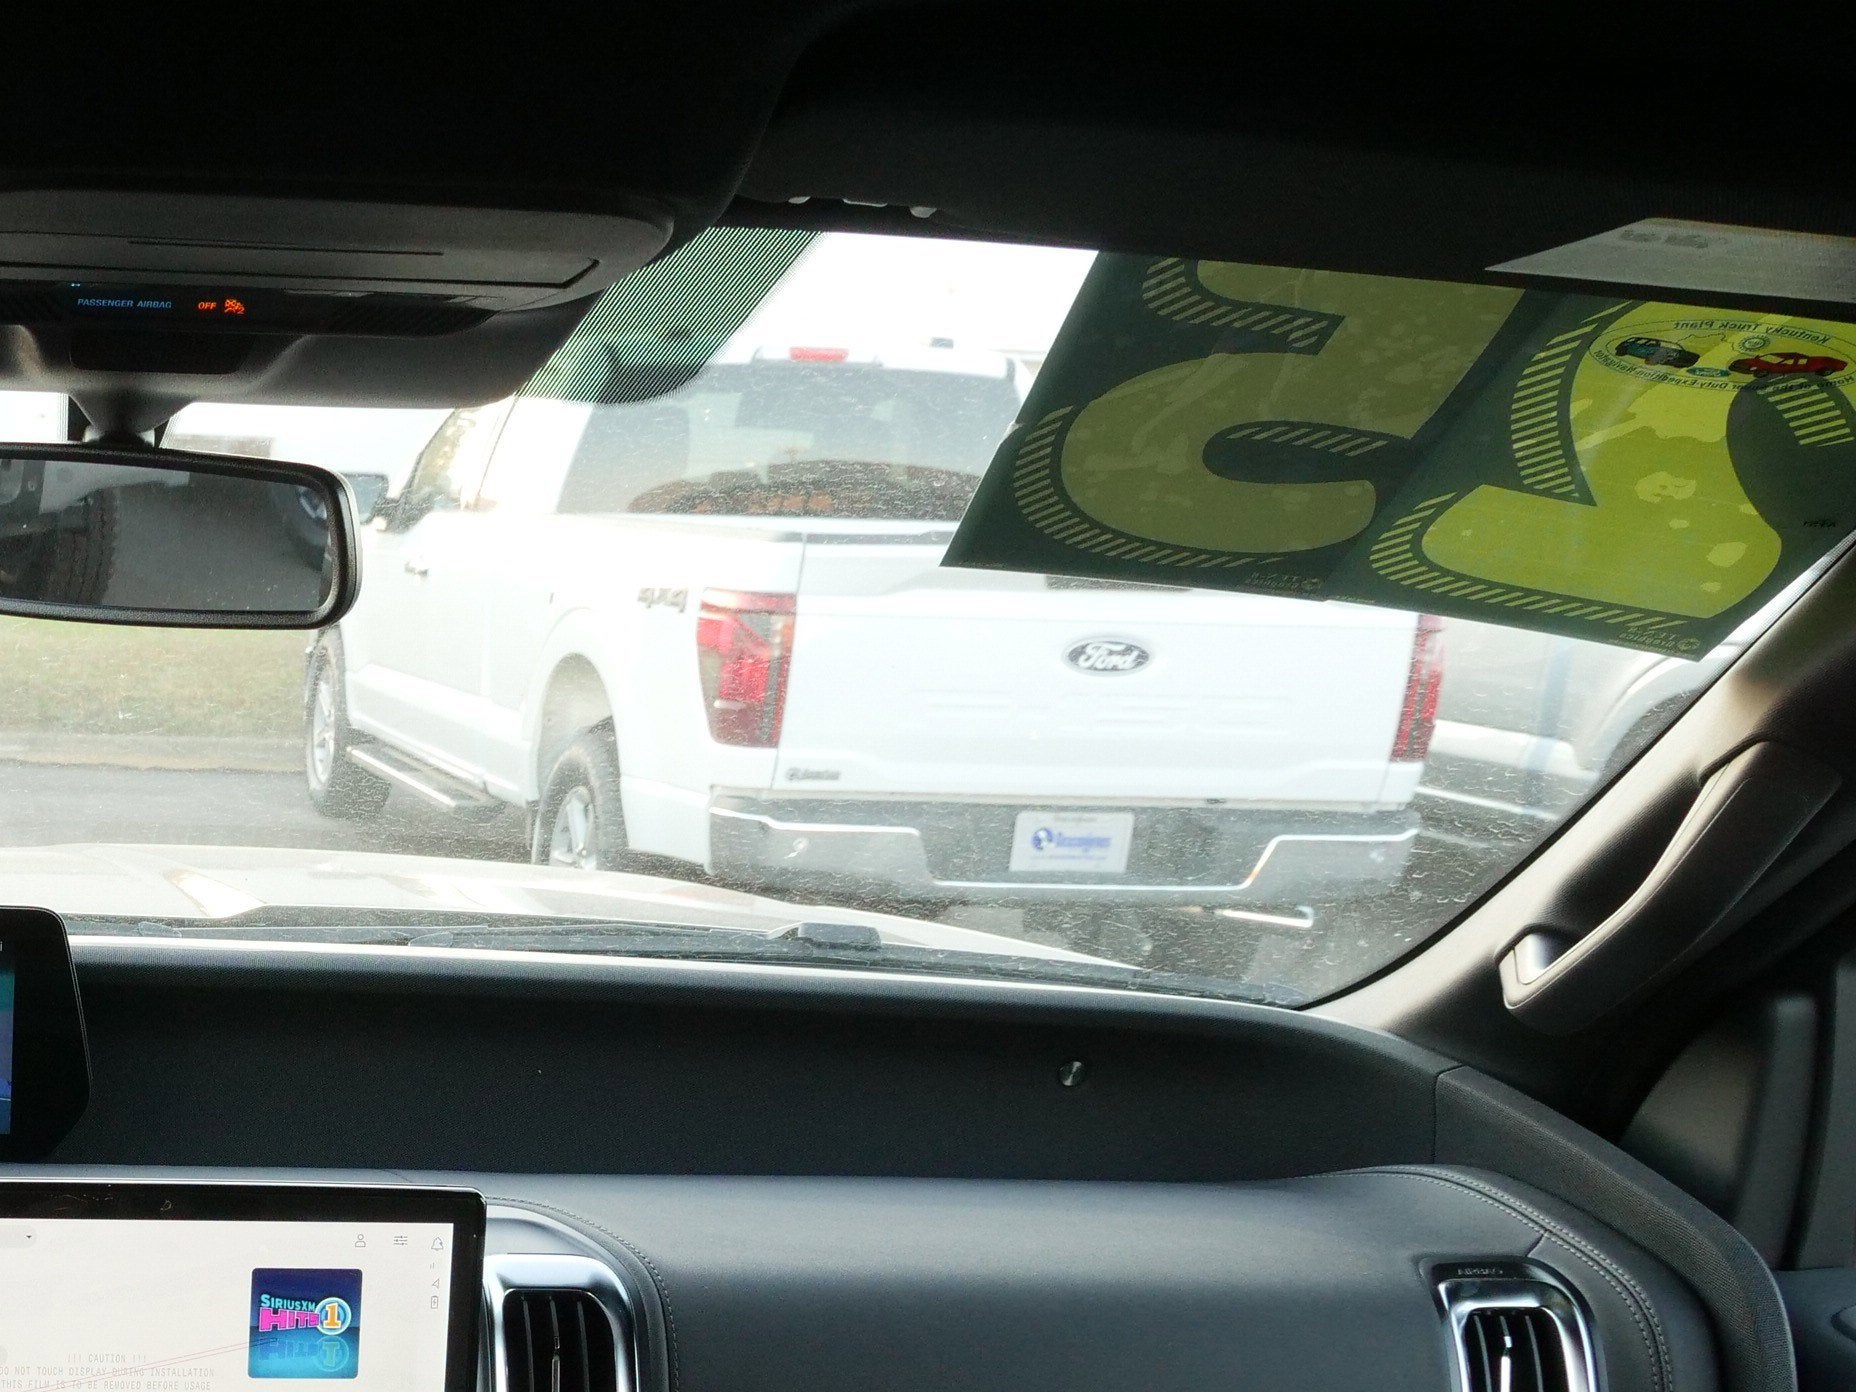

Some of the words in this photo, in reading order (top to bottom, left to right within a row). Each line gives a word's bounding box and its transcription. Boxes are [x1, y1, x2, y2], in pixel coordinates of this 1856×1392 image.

[77, 298, 133, 308] PASSENGER
[137, 301, 172, 309] AIRBAG
[198, 302, 216, 310] OFF
[1077, 638, 1143, 672] Ford
[259, 1307, 320, 1332] HITS
[323, 1302, 342, 1328] 1
[88, 1354, 127, 1363] CAUTION
[14, 1367, 31, 1376] NOT
[37, 1367, 64, 1376] TOUCH
[68, 1367, 107, 1377] DISPLAY
[150, 1368, 215, 1378] INSTALLATION
[1, 1380, 23, 1389] THIS
[28, 1380, 50, 1389] FILM
[56, 1380, 66, 1390] IS
[71, 1380, 82, 1390] TO
[87, 1380, 98, 1390] BE
[103, 1381, 142, 1390] REMOVED
[146, 1381, 179, 1391] BEFORE
[184, 1381, 211, 1391] USAGE
